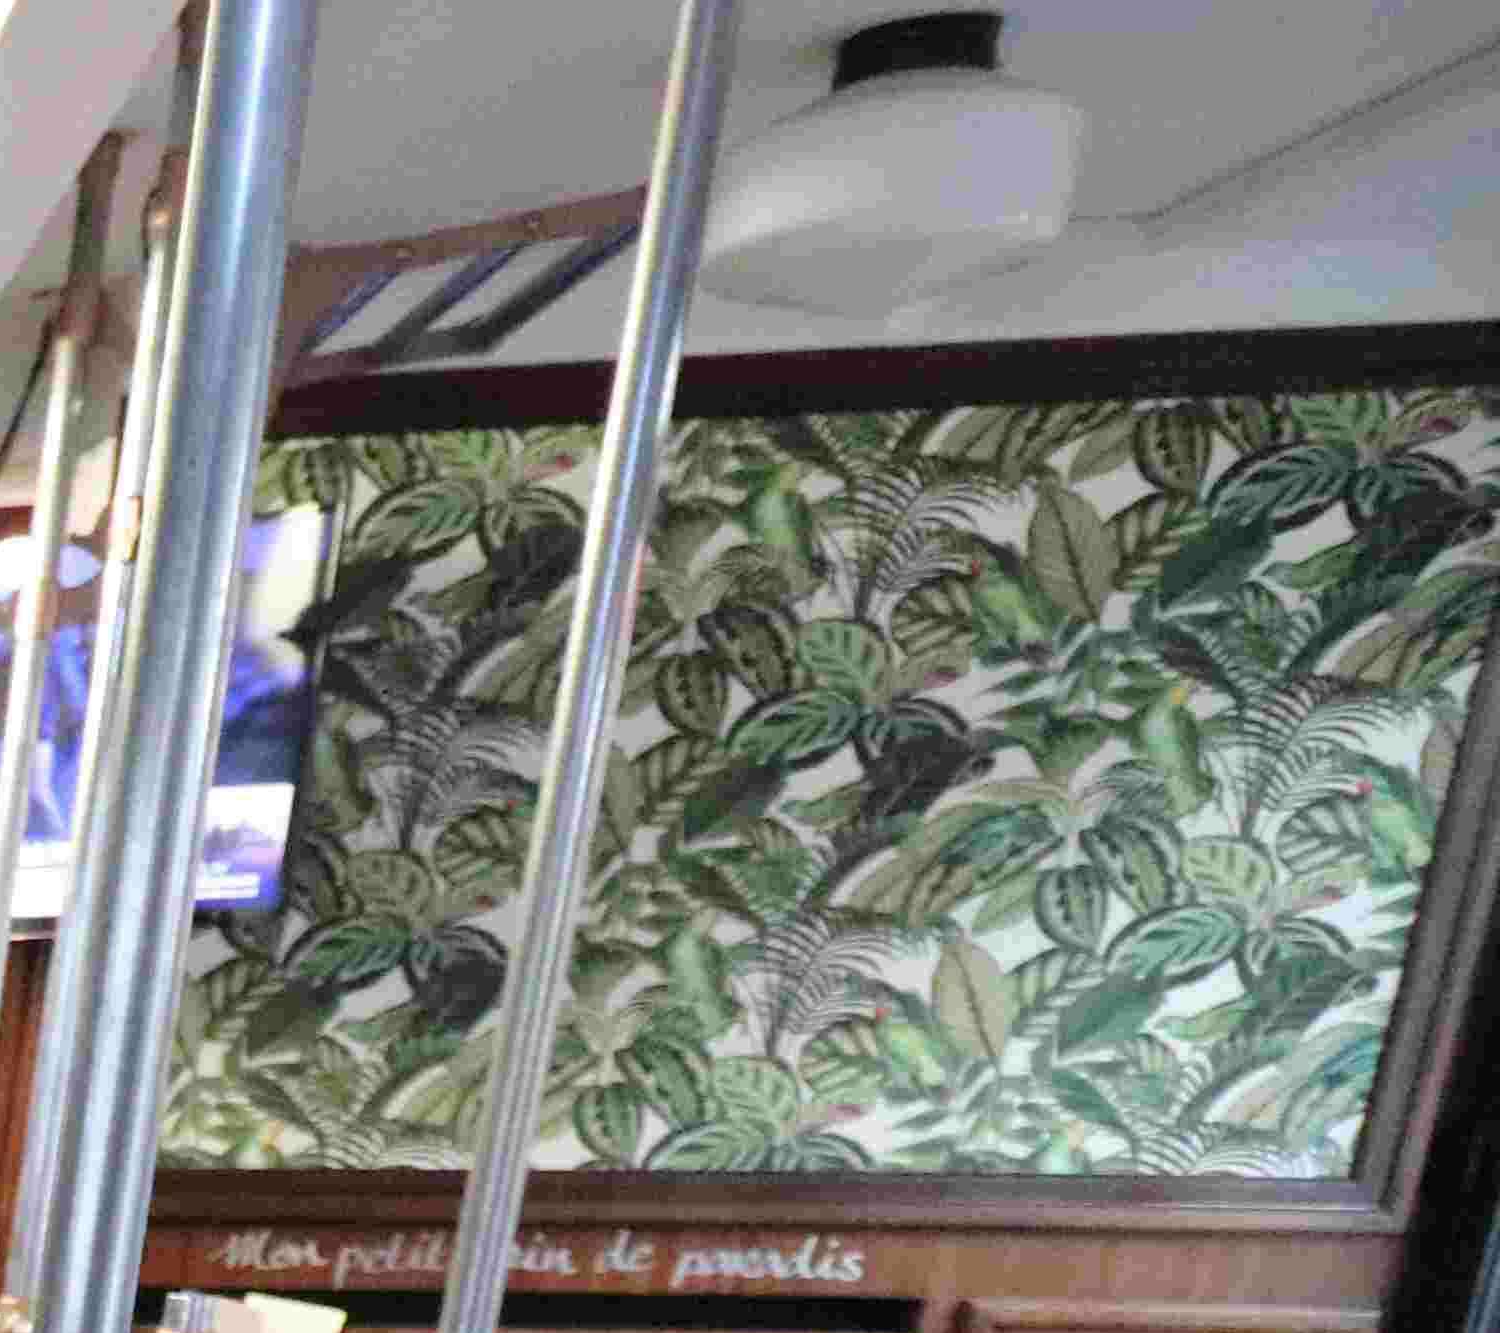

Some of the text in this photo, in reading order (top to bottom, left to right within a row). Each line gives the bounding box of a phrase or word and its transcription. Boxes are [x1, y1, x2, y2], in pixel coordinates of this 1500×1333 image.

[205, 1229, 329, 1270] Mon
[332, 1231, 446, 1290] petit
[594, 1228, 655, 1278] de
[669, 1233, 865, 1289] paradis
